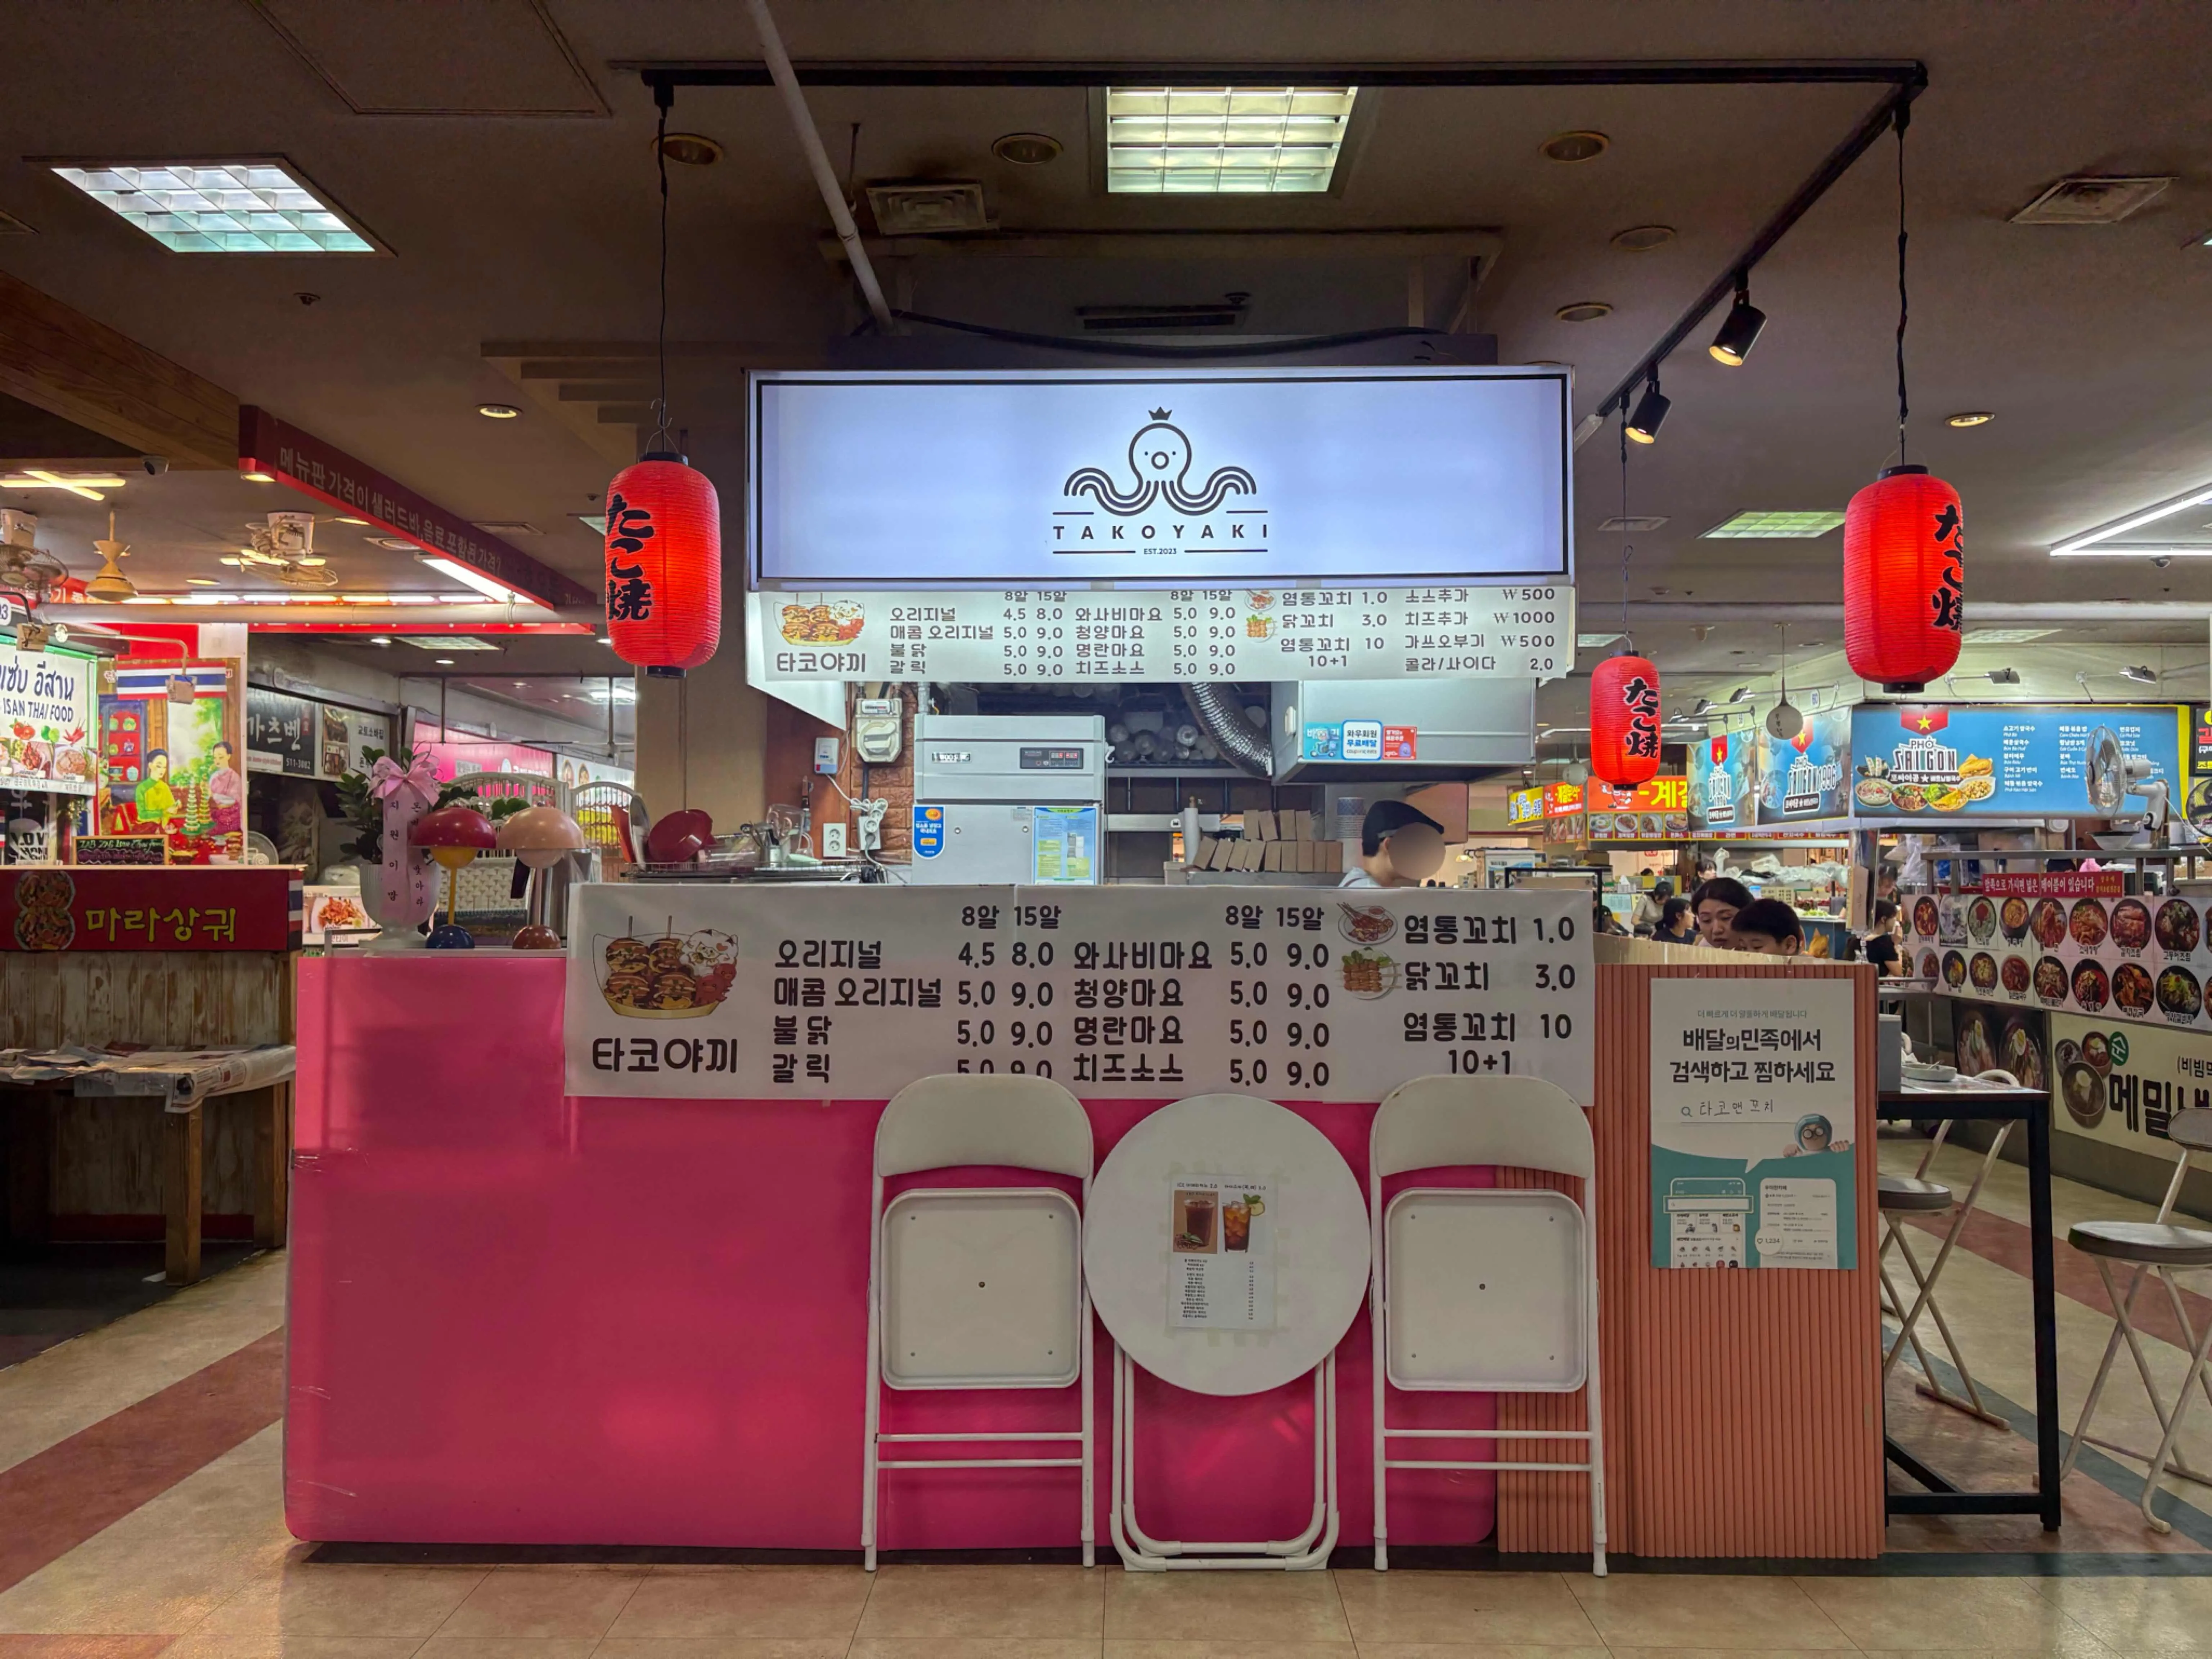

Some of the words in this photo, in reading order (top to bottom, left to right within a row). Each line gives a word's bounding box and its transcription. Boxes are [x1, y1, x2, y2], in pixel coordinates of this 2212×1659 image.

[281, 447, 324, 490] 메뉴판
[329, 472, 369, 513] 가격이
[448, 538, 477, 562] 포함된
[1053, 523, 1267, 540] TAKOYAKI
[607, 493, 655, 621] たこ焼
[1005, 591, 1028, 602] 8알
[1037, 591, 1067, 602] 15알
[1170, 591, 1194, 602] 8알
[1203, 591, 1232, 602] 15알
[1282, 591, 1352, 606] 염통꼬치
[1362, 592, 1387, 605] 1.0
[1405, 588, 1469, 603] 소스추가
[890, 607, 955, 621] 오리지널
[1003, 608, 1026, 621] 4.5
[1037, 608, 1062, 621] 8.0
[1075, 607, 1163, 621] 와사비마요
[1174, 607, 1197, 620] 5.0
[1209, 607, 1235, 620] 9.0
[1282, 613, 1333, 628] 닭꼬치
[1362, 614, 1387, 627] 3.0
[1405, 611, 1468, 626] 치즈추가
[890, 625, 922, 640] 매콤
[927, 625, 993, 640] 오리지널
[1004, 626, 1027, 640] 5.0
[1037, 627, 1063, 640] 9.0
[1076, 625, 1145, 640] 청양마요
[1174, 626, 1197, 639] 5.0
[1209, 626, 1235, 639] 9.0
[1281, 637, 1349, 653] 염통꼬치
[1366, 637, 1384, 649] 10
[1405, 634, 1484, 649] 가쓰오부기
[777, 653, 866, 673] 타코야끼
[1004, 645, 1027, 658] 5.0
[1037, 646, 1063, 659] 9.0
[1076, 643, 1145, 658] 명란마요
[1174, 644, 1197, 657] 5.0
[1209, 644, 1235, 658] 9.0
[1309, 655, 1346, 667] 10+1
[1405, 656, 1496, 671] 콜라/사이다
[1530, 658, 1553, 671] 2.0
[1004, 664, 1027, 676] 5.0
[1037, 664, 1063, 677] 9.0
[1076, 661, 1145, 675] 치즈소스
[1174, 663, 1197, 676] 5.0
[1209, 663, 1235, 676] 9.0
[3, 698, 25, 716] ISAN
[28, 701, 49, 720] THAI
[50, 704, 74, 722] FOOD
[1346, 729, 1377, 738] 와우회원
[1346, 739, 1377, 748] 무료배달
[2041, 876, 2066, 892] 테이블이
[2068, 876, 2095, 893] 있습니다
[85, 907, 236, 942] 마라상궈
[962, 905, 1000, 929] 8알
[1014, 905, 1062, 929] 15알
[1226, 905, 1263, 929] 8알
[1276, 907, 1325, 931] 15알
[1404, 915, 1516, 944] 염통꼬치
[1533, 917, 1574, 943] 1.0
[775, 940, 881, 969] 오리지널
[958, 942, 994, 968] 4.5
[1012, 941, 1053, 968] 8.0
[1074, 941, 1212, 970] 와사비마요
[1231, 941, 1267, 968] 5.0
[1287, 943, 1329, 970] 9.0
[1405, 961, 1489, 991] 닭꼬치
[1536, 964, 1575, 991] 3.0
[774, 977, 826, 1007] 매콤
[835, 977, 941, 1007] 오리지널
[958, 980, 995, 1008] 5.0
[1012, 982, 1053, 1009] 9.0
[1074, 978, 1184, 1008] 청양마요
[1231, 980, 1267, 1008] 5.0
[1287, 983, 1329, 1010] 9.0
[1698, 1010, 1705, 1018] 더
[1706, 1010, 1728, 1018] 빠르게
[1730, 1010, 1737, 1018] 더
[1739, 1010, 1768, 1019] 알뜰하게
[1770, 1010, 1807, 1019] 배달됩니다
[957, 1020, 994, 1047] 5.0
[1011, 1021, 1052, 1048] 9.0
[1074, 1016, 1183, 1046] 명란마요
[1230, 1019, 1267, 1047] 5.0
[1287, 1022, 1329, 1049] 9.0
[1404, 1012, 1515, 1042] 염통꼬치
[1541, 1014, 1572, 1039] 10
[1683, 1028, 1821, 1051] 배달의민족에서
[593, 1038, 738, 1073] 타코야끼
[1074, 1053, 1183, 1082] 치즈소스
[1230, 1059, 1268, 1086] 5.0
[1287, 1061, 1329, 1088] 9.0
[1449, 1049, 1510, 1074] 10+1
[1670, 1061, 1749, 1083] 검색하고
[1754, 1061, 1836, 1084] 찜하세요
